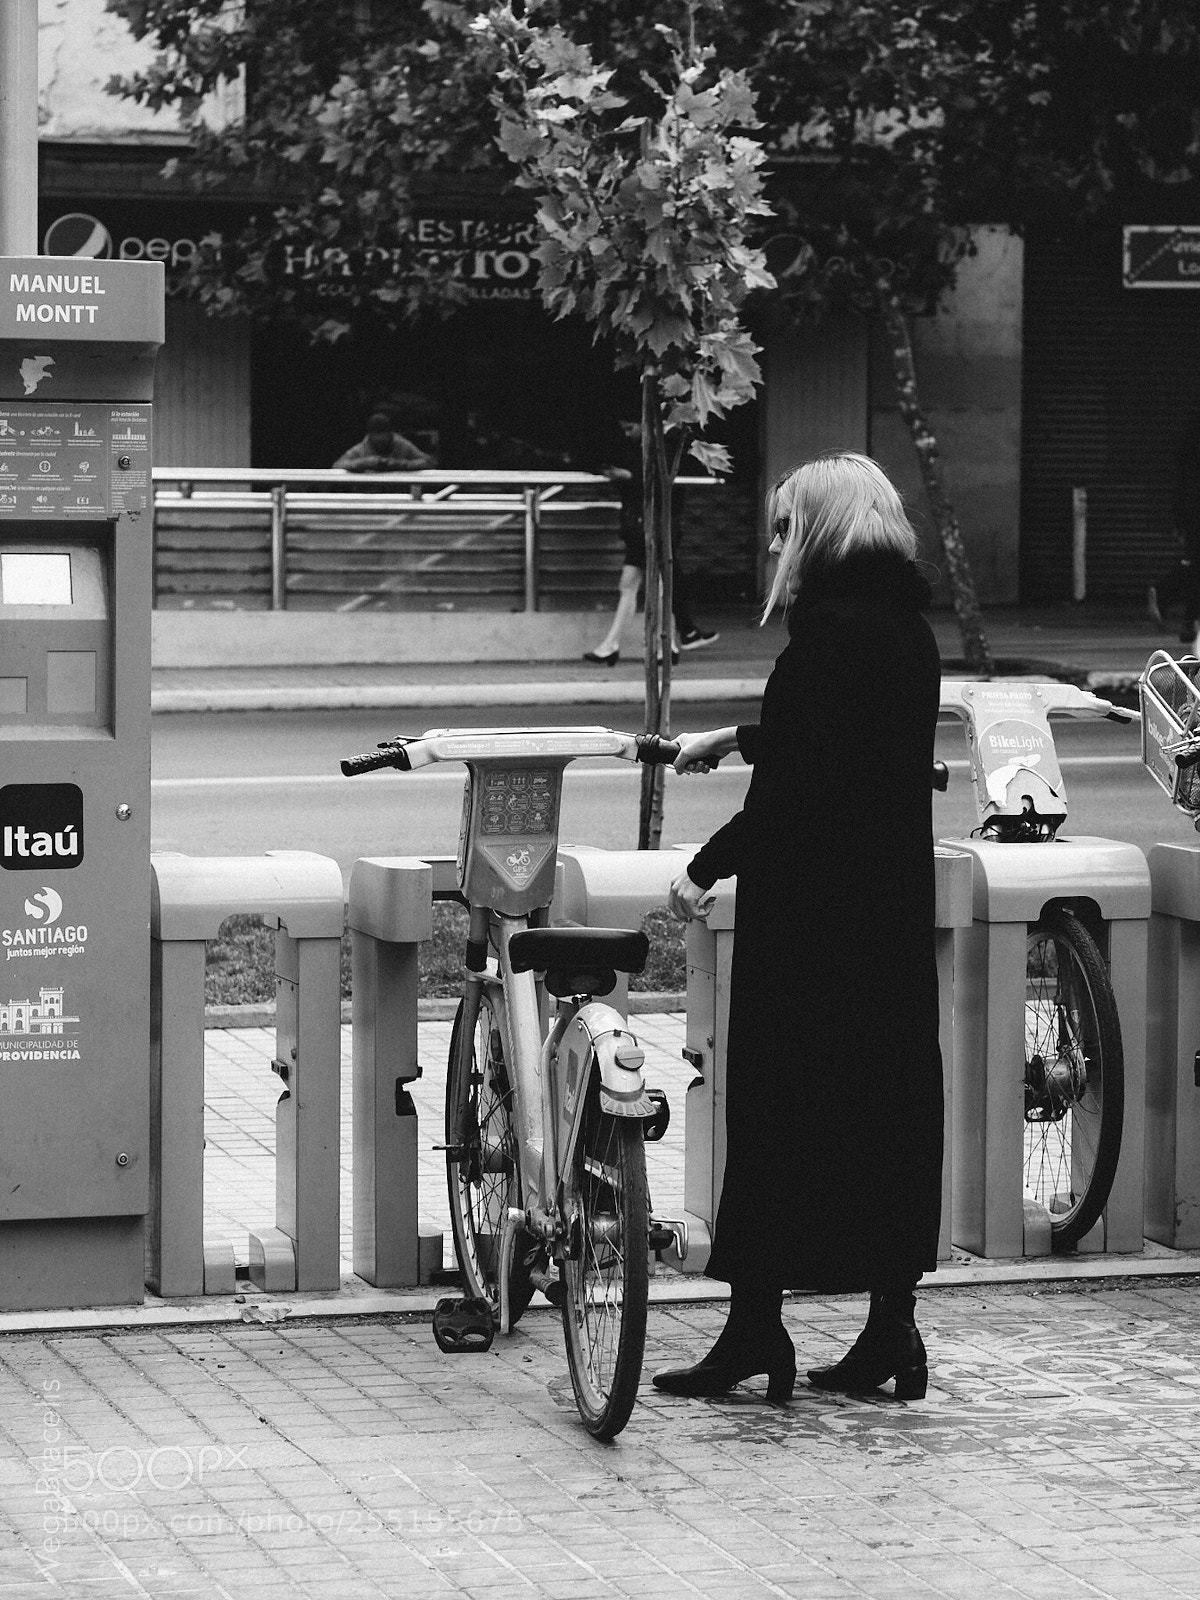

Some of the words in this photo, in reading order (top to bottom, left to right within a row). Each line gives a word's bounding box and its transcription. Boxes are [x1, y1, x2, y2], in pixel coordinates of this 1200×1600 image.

[10, 274, 106, 295] MANUEL
[16, 303, 99, 324] MONTT
[989, 735, 1045, 751] BikeLight
[4, 825, 78, 857] Itaú
[512, 865, 528, 874] GPS
[2, 925, 88, 947] SANTIAGO
[6, 948, 33, 961] juntos
[33, 946, 57, 959] mejor
[58, 944, 85, 957] región
[66, 1039, 79, 1049] DE
